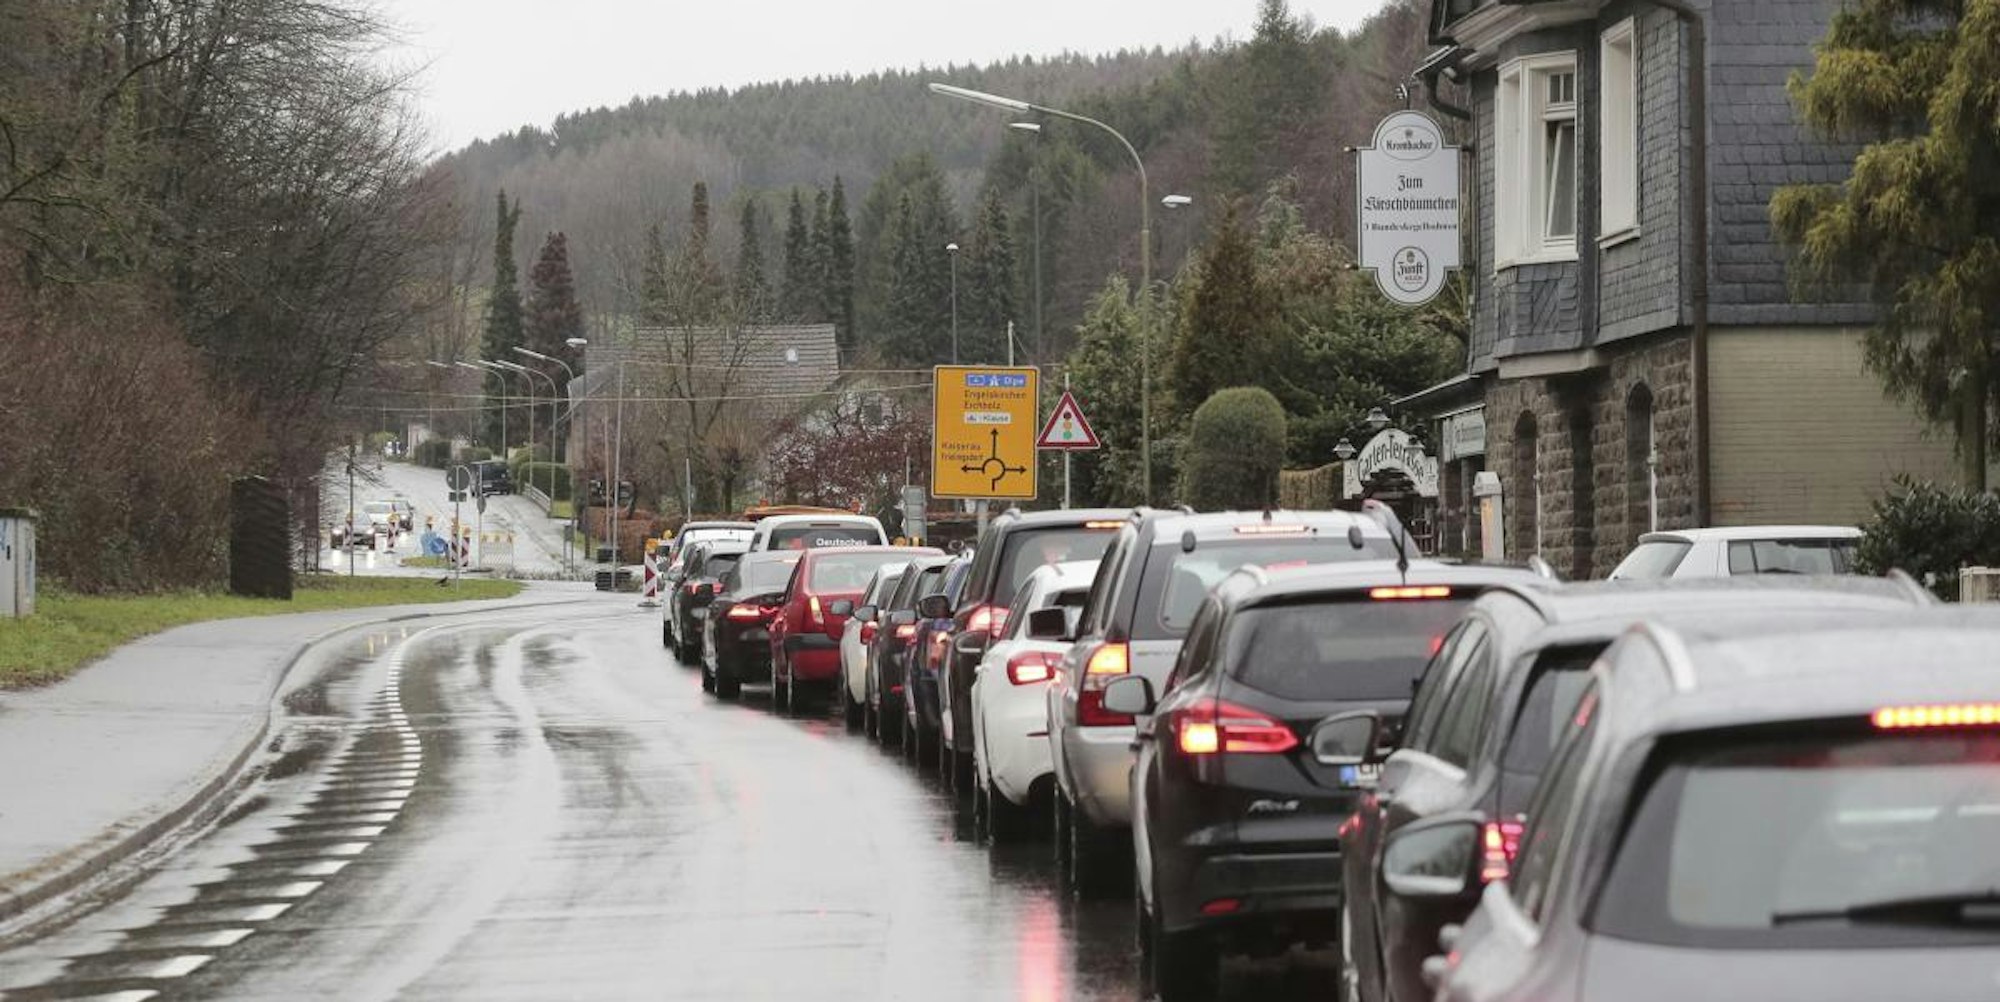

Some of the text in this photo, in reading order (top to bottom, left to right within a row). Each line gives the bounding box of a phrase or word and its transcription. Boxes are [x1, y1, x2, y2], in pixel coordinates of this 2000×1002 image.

[1386, 139, 1433, 150] Krombacher
[1397, 175, 1423, 191] Zum
[1397, 261, 1424, 276] Zunft
[1004, 376, 1025, 387] Olpe
[964, 389, 1027, 400] Engelskirchen
[815, 538, 868, 547] Deutsches
